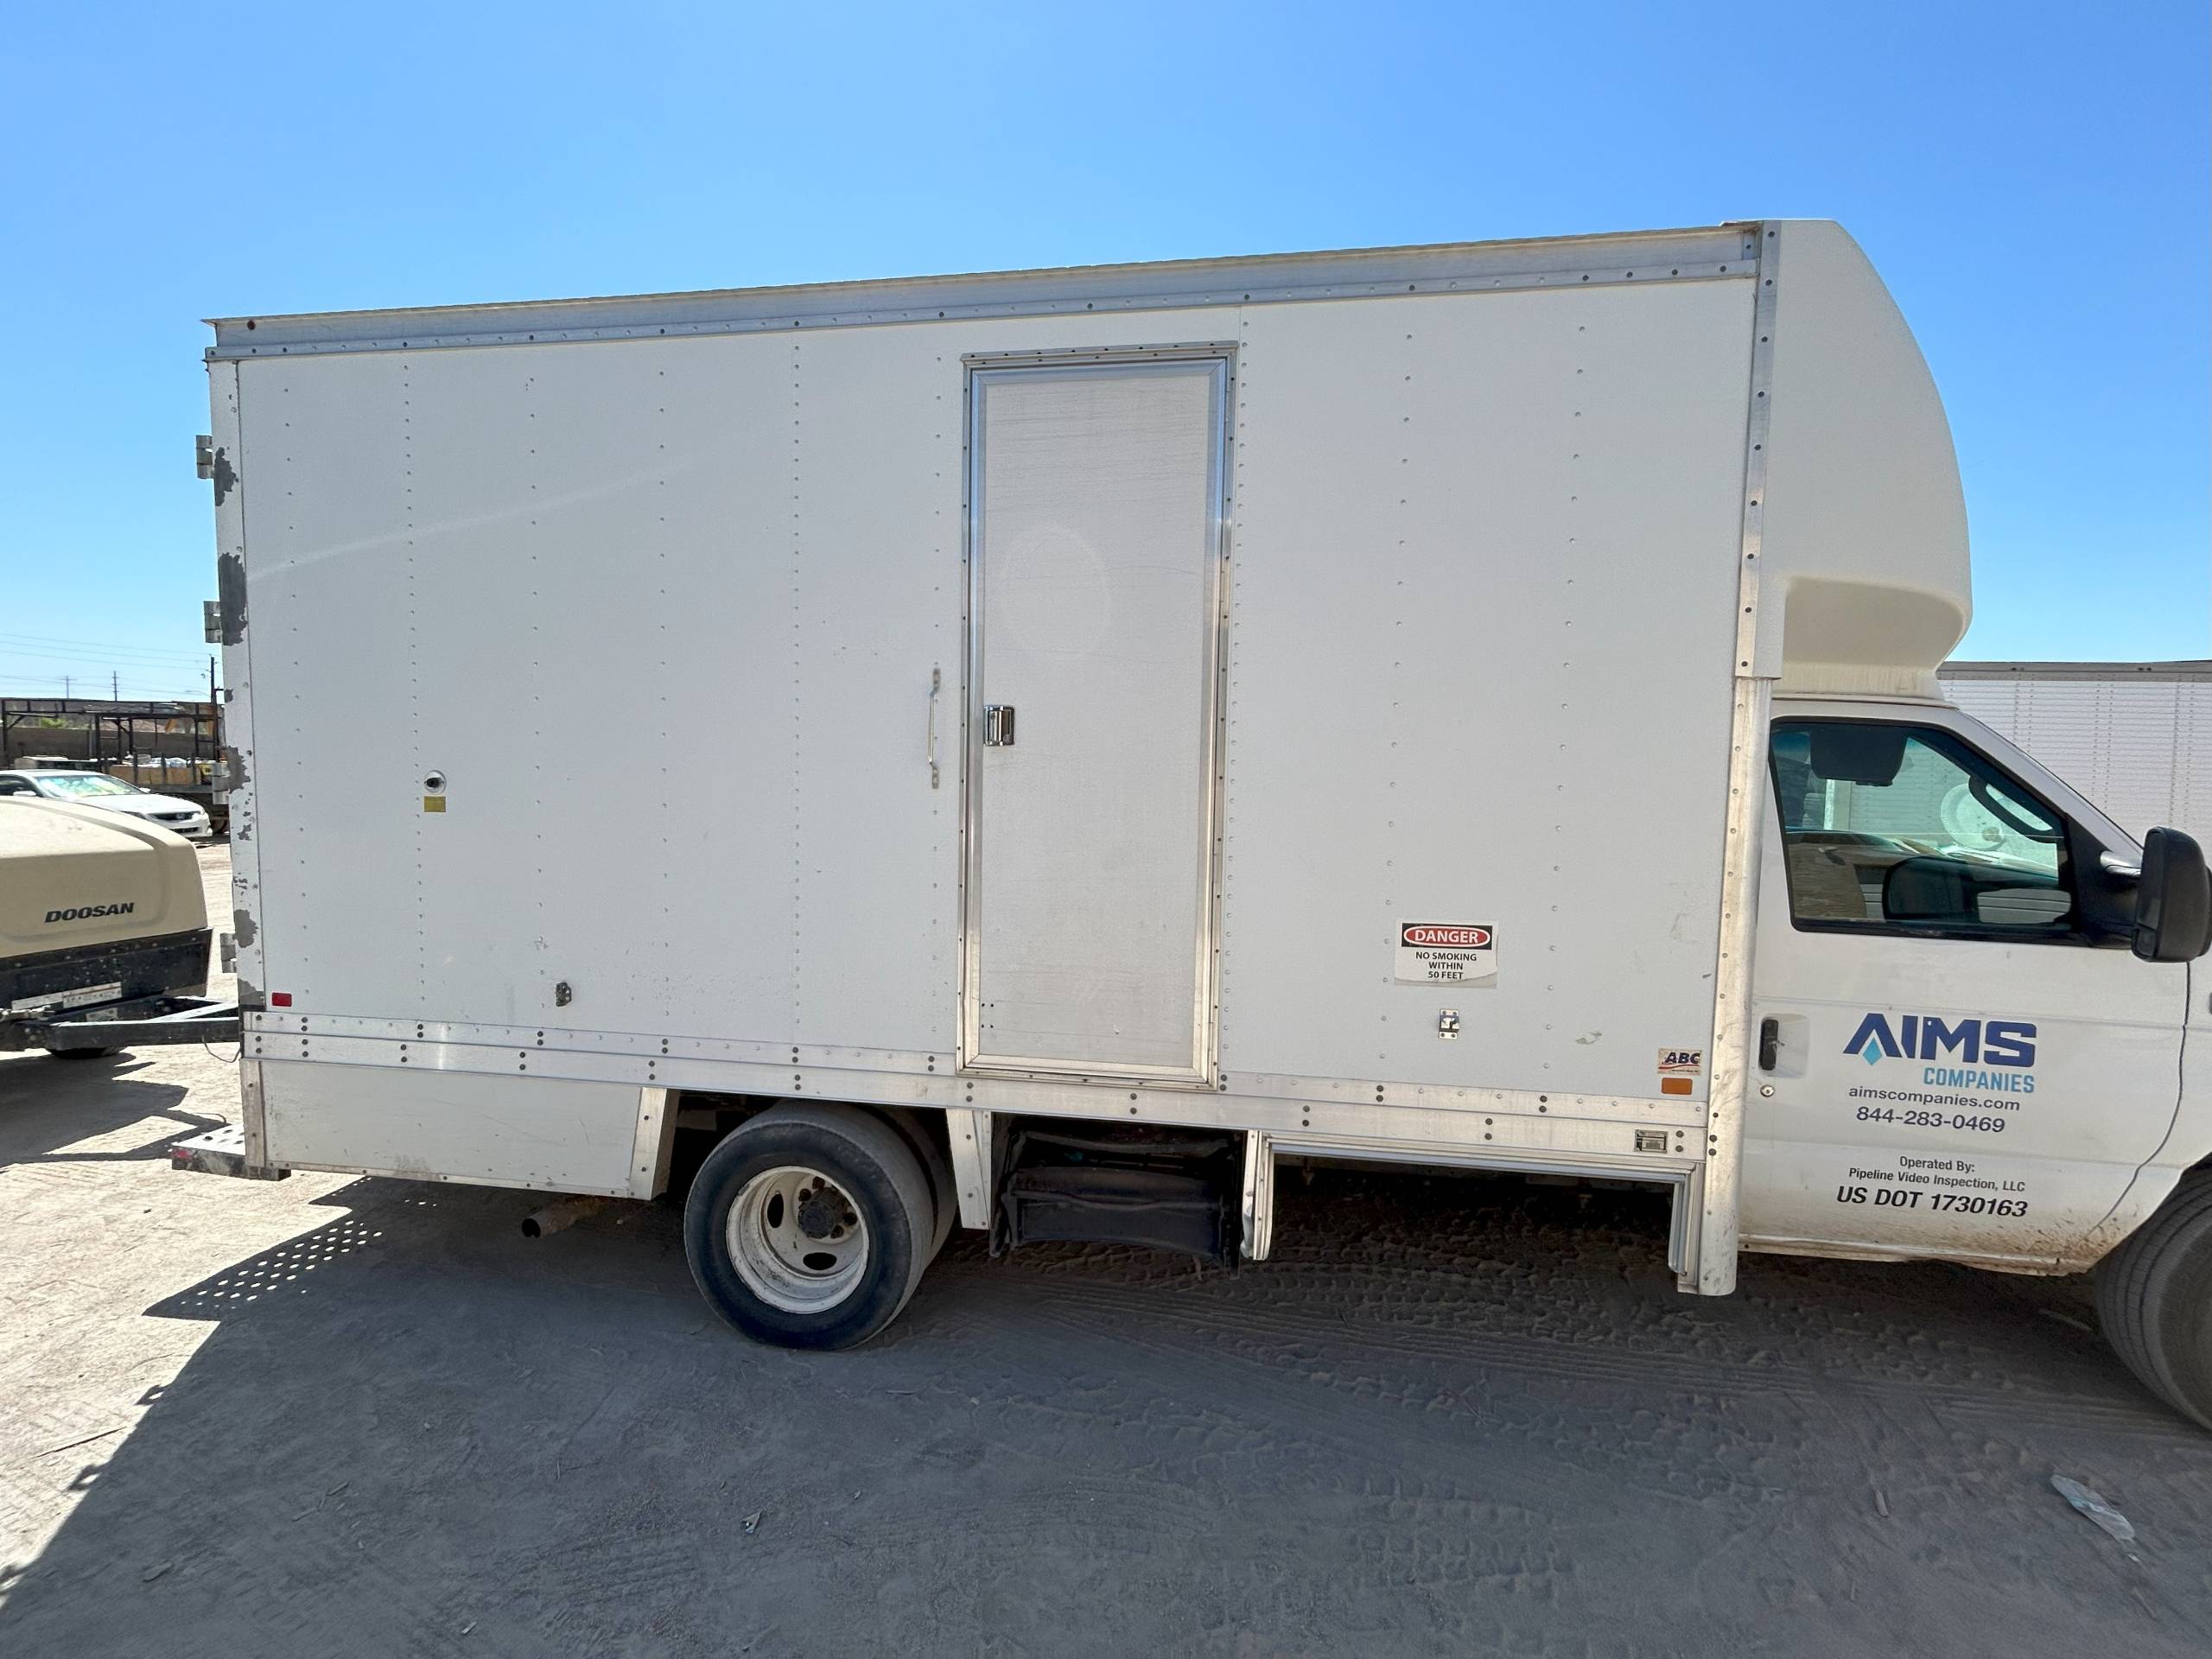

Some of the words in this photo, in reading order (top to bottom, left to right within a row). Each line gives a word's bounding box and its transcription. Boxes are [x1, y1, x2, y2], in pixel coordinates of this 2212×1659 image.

[45, 902, 135, 923] DOOSAN
[1414, 930, 1478, 944] DANGER
[1415, 951, 1430, 960] NO
[1432, 952, 1477, 962] SMOKING
[1428, 962, 1464, 970] WITHIN
[1427, 970, 1440, 979] 50
[1441, 971, 1464, 980] FEET
[1843, 1013, 2037, 1068] AIMS
[1664, 1052, 1701, 1065] ABC
[1923, 1067, 2035, 1094] COMPANIES
[1848, 1086, 2020, 1110] aimscompanies.com
[1856, 1106, 2005, 1133] 844-283-0469
[1899, 1156, 1953, 1171] Operated
[1956, 1160, 1975, 1173] By:
[1848, 1167, 1894, 1181] Pipeline
[1897, 1171, 1929, 1184] Video
[1933, 1174, 1999, 1191] Inspection,
[2003, 1180, 2025, 1192] LLC
[1837, 1185, 1867, 1204] US
[1874, 1188, 1923, 1208] DOT
[1930, 1194, 2028, 1217] 1730163
